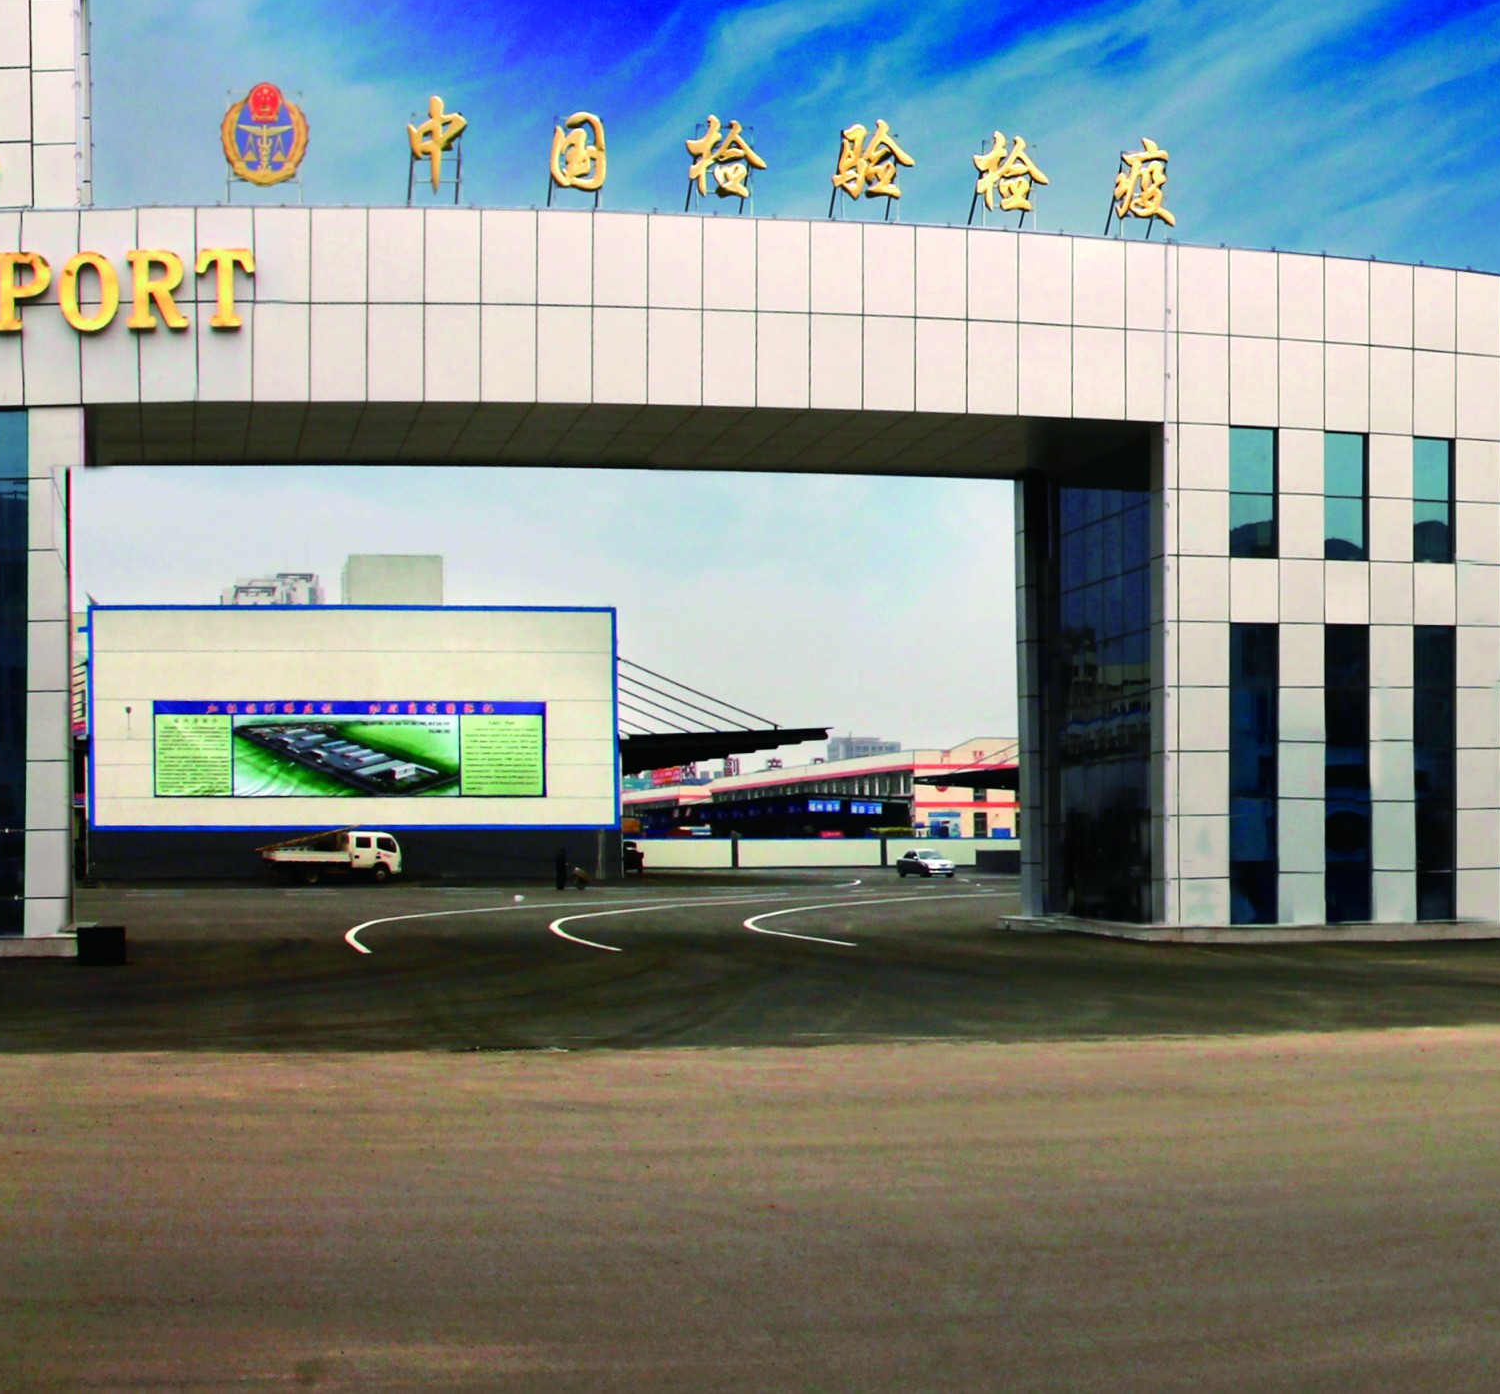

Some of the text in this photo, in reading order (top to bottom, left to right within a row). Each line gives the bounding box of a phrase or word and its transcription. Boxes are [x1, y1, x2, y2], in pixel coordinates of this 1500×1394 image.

[407, 95, 1176, 228] 中国检验检疫
